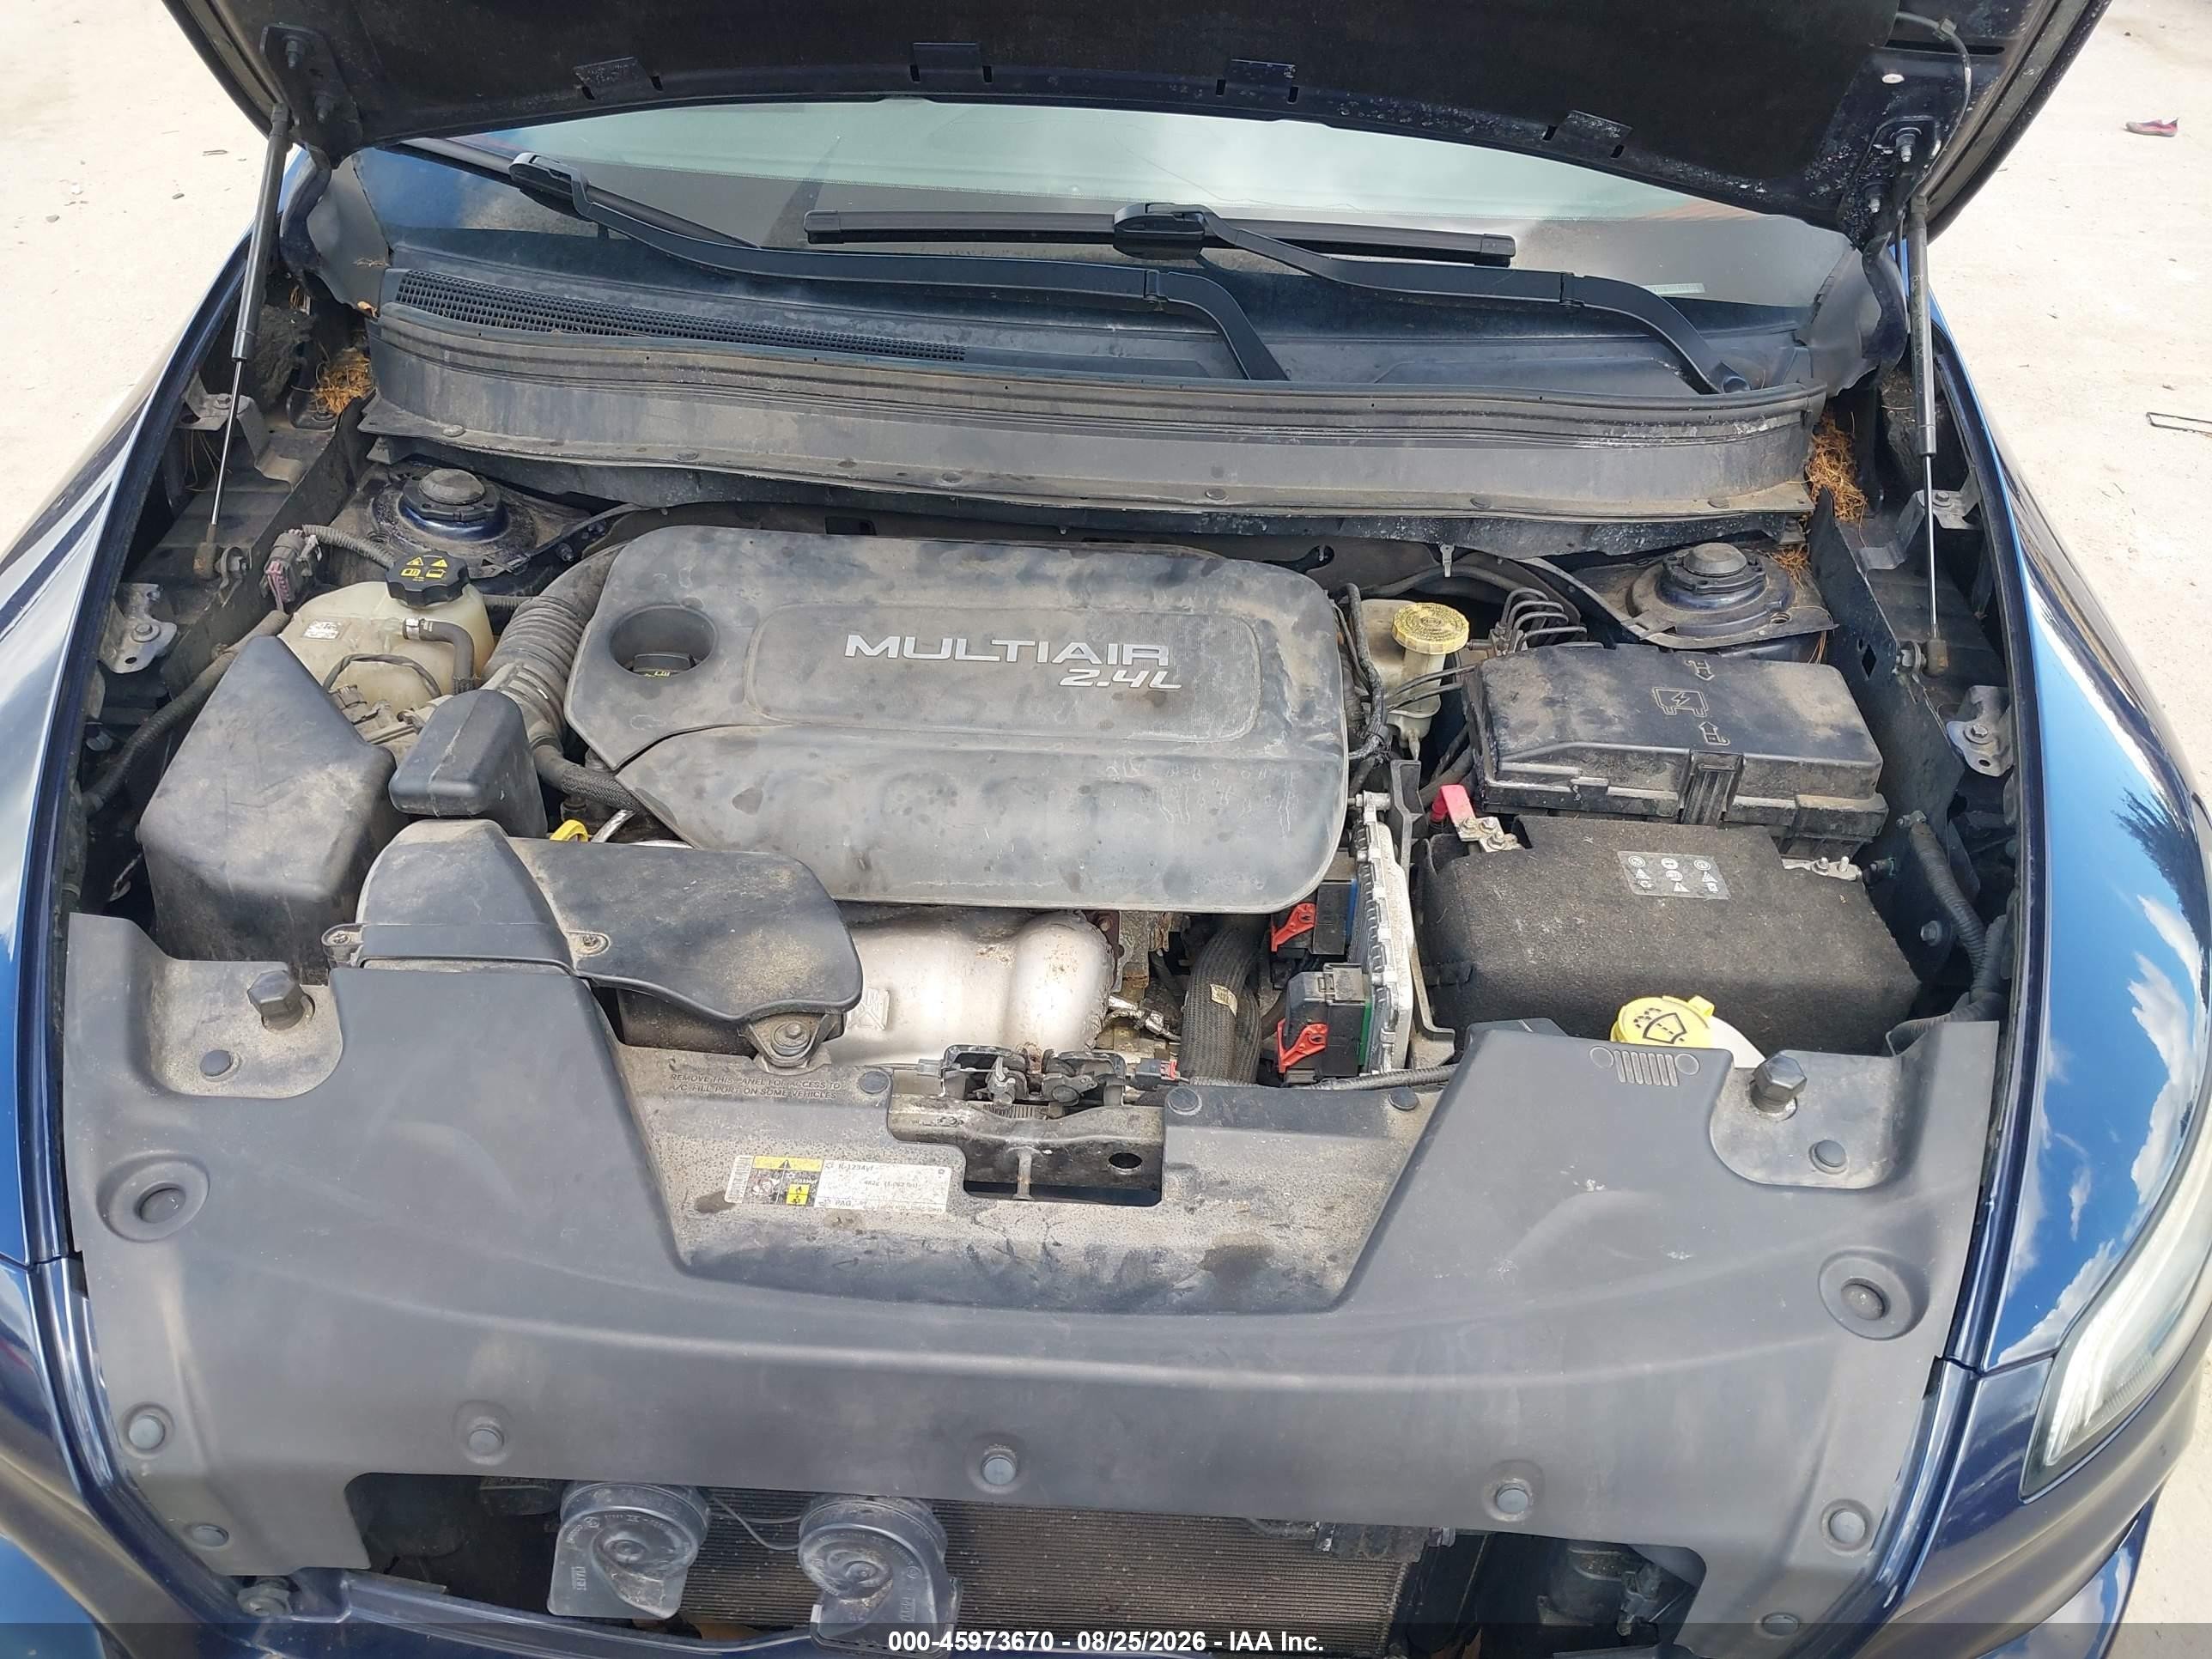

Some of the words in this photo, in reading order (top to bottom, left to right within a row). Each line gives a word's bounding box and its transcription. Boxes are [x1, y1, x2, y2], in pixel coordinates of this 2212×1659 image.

[844, 635, 1170, 666] MULTIAIR
[1059, 668, 1182, 690] 2.4L
[671, 1073, 710, 1084] REMOVE
[737, 1078, 764, 1086] ANEL
[692, 1085, 712, 1093] FILL
[760, 1088, 788, 1097] SOME
[790, 1090, 837, 1099] VEHICLES
